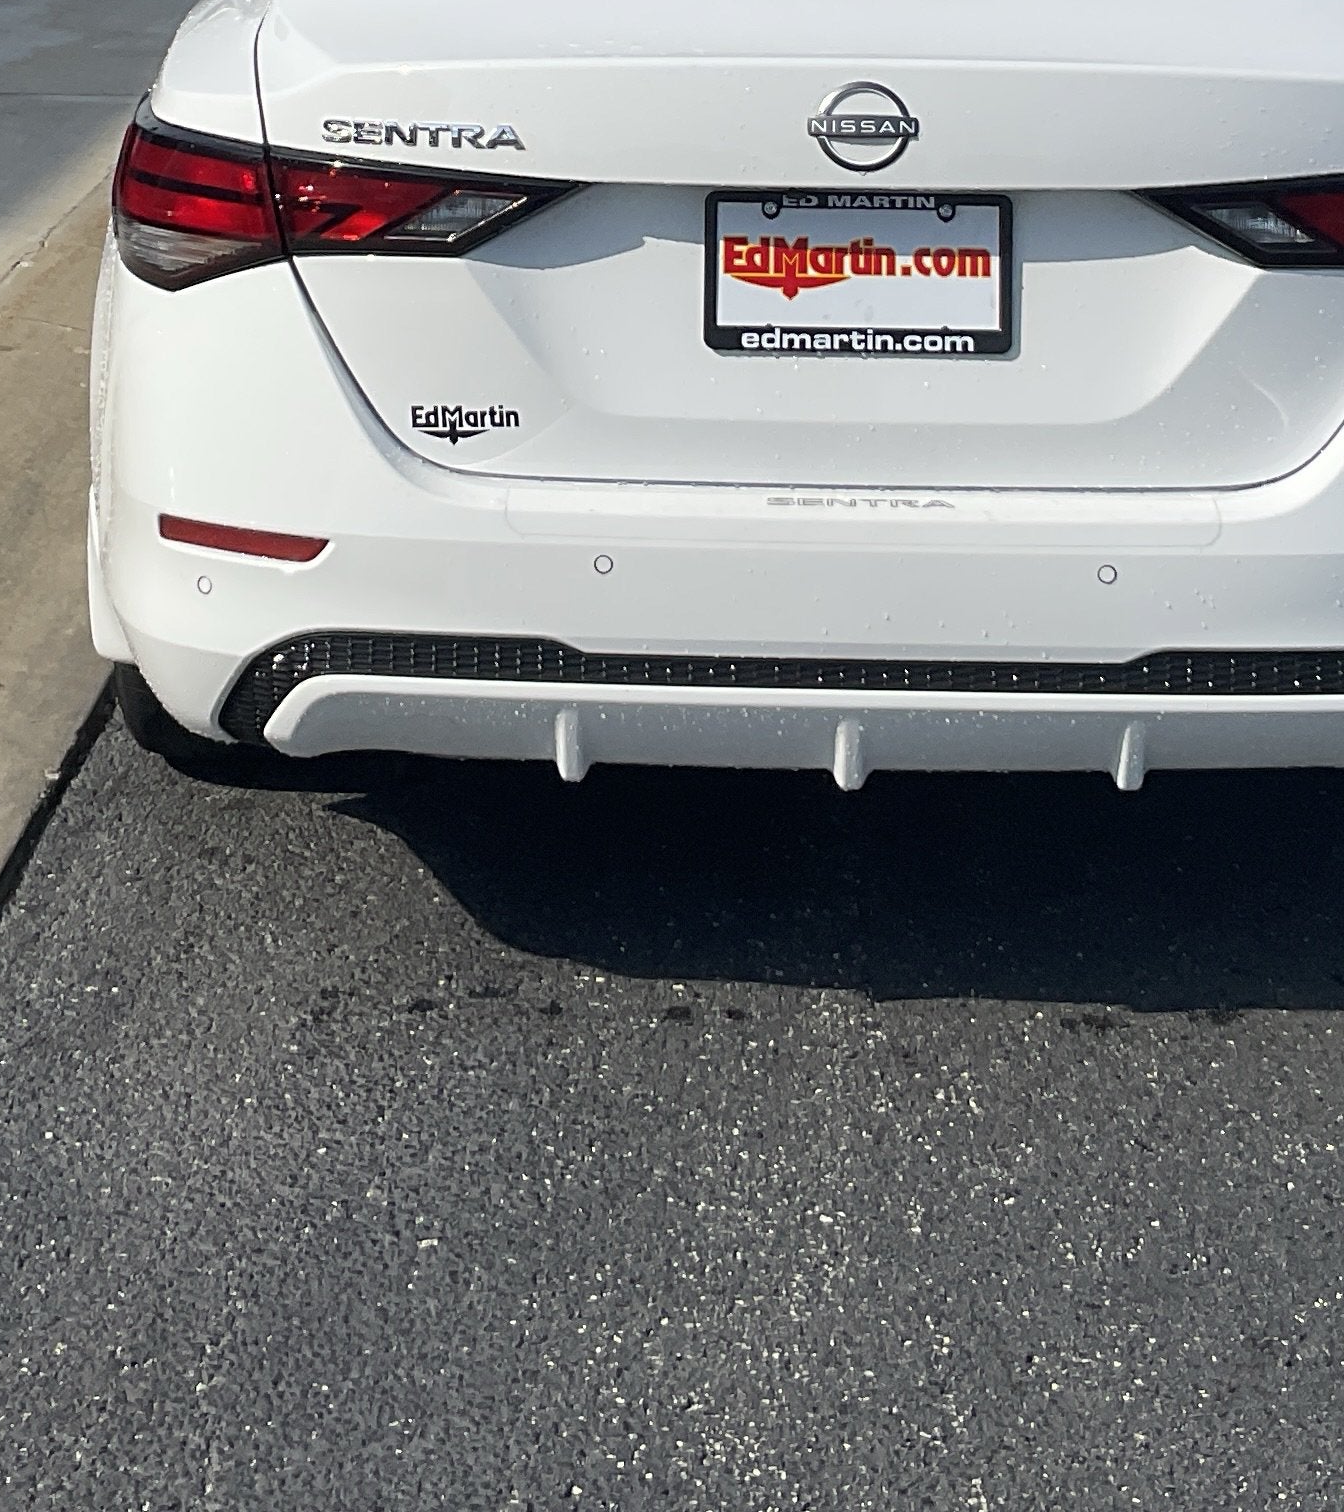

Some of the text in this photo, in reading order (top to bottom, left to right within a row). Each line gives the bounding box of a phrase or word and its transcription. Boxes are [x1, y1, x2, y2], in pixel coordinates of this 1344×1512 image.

[321, 117, 527, 151] SENTRA
[810, 119, 916, 134] NISSAN
[782, 194, 936, 209] ED MARTIN
[740, 328, 975, 352] edmartin.com
[767, 497, 955, 508] SENTRA
